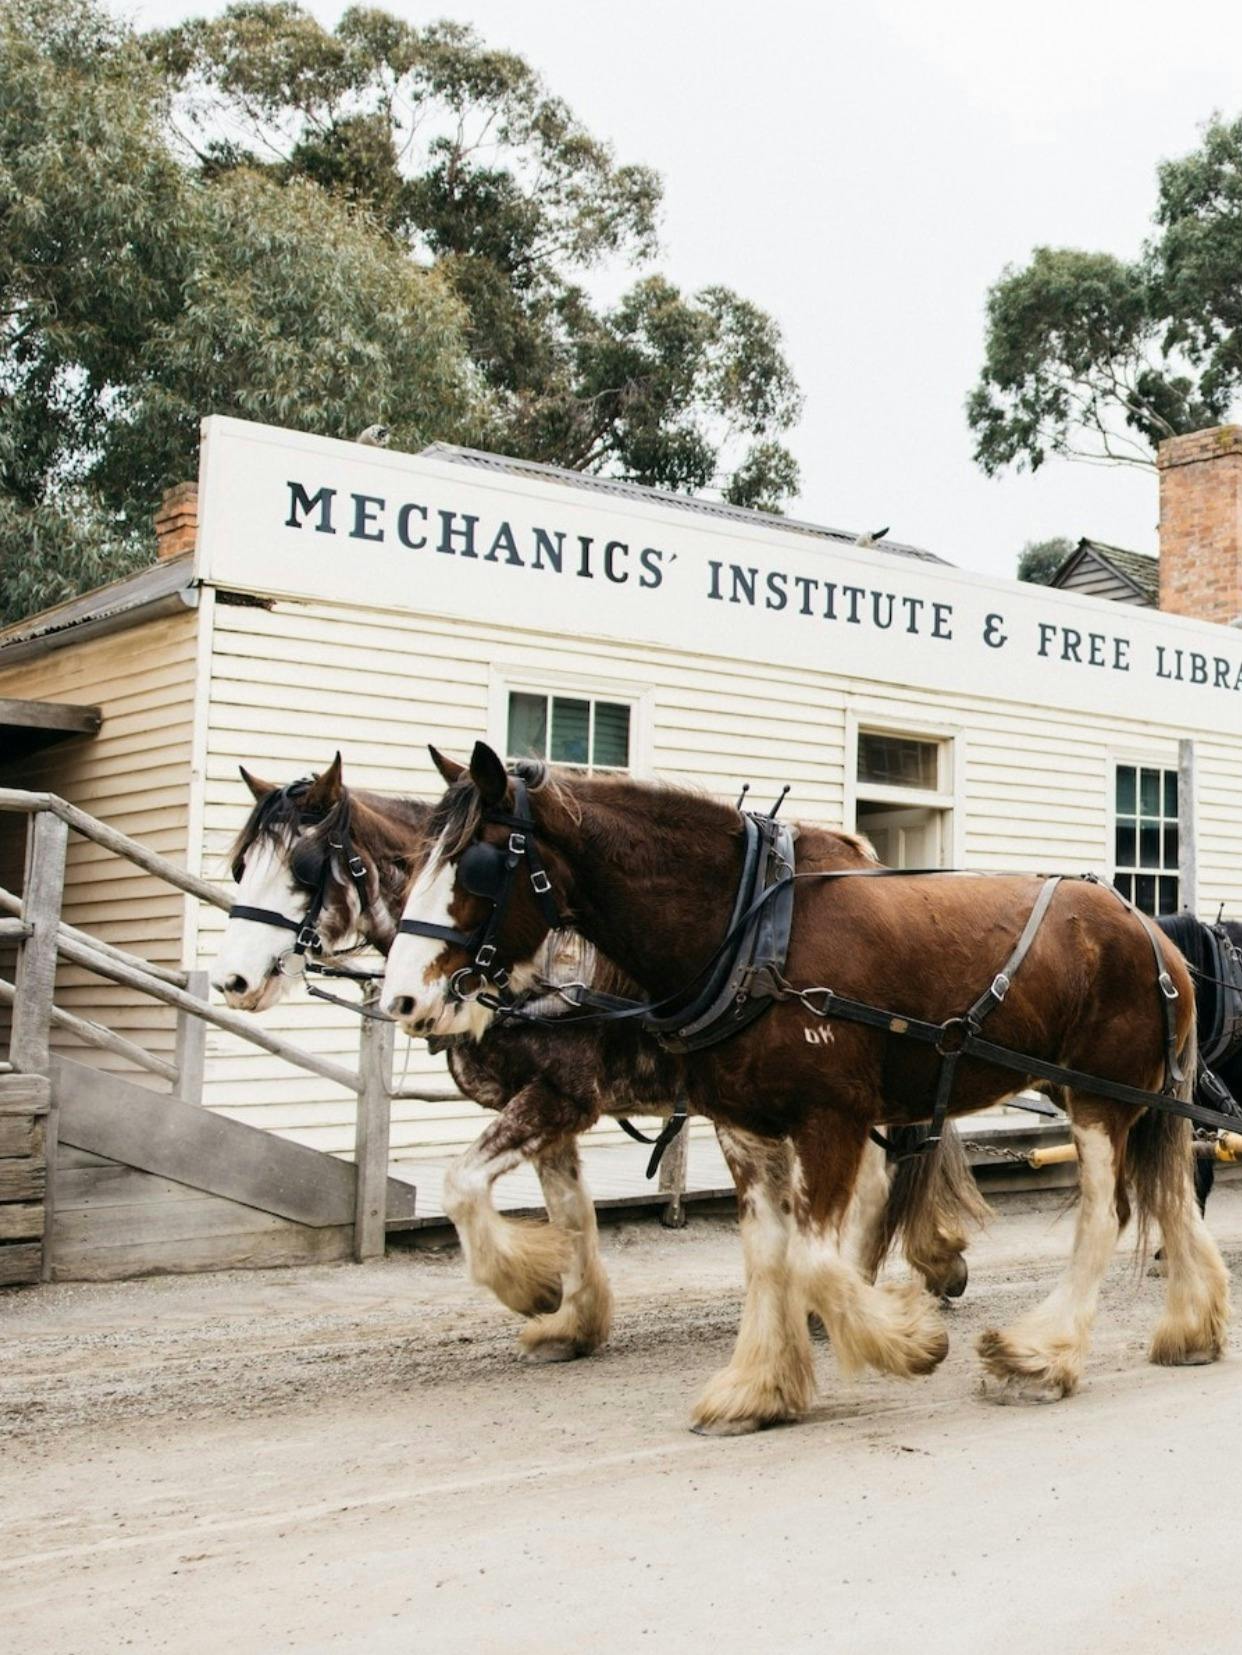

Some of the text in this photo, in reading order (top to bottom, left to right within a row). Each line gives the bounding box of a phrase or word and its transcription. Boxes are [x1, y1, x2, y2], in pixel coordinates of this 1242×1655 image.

[707, 560, 953, 640] INSTITUTE
[983, 613, 1008, 649] &
[1037, 623, 1131, 672] FREE
